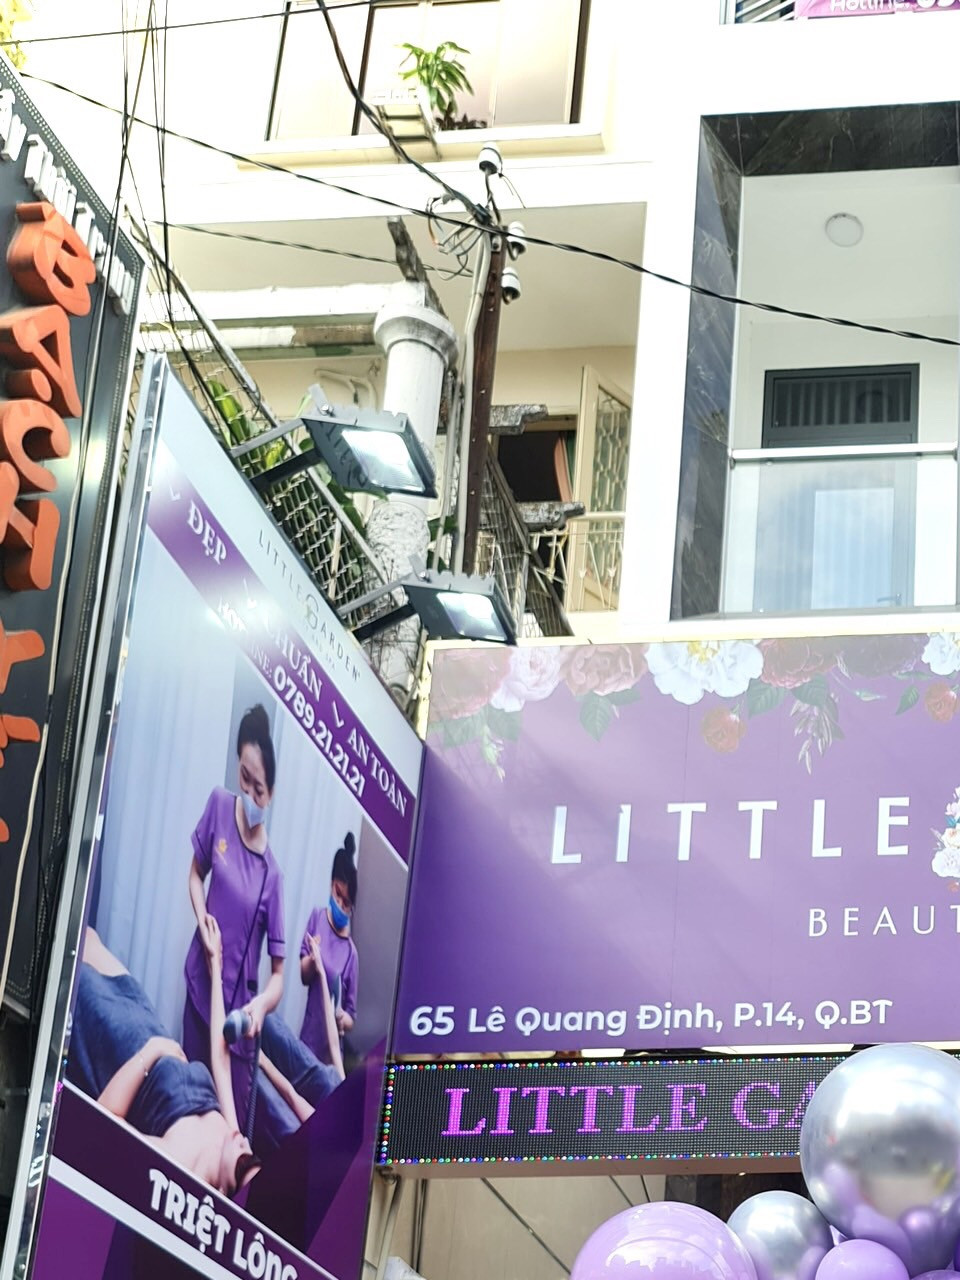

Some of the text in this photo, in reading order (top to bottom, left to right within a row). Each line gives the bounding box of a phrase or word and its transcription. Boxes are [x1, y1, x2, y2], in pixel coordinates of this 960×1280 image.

[187, 501, 228, 566] ĐẸP
[371, 755, 407, 818] TOÀN
[273, 664, 366, 798] 0789.21.21.21
[551, 796, 911, 864] LITTLE
[409, 999, 893, 1037] 65 Lê Quang Định, P.14, Q.BT
[441, 1083, 709, 1138] LITTLE
[149, 1168, 231, 1254] TRIỆT
